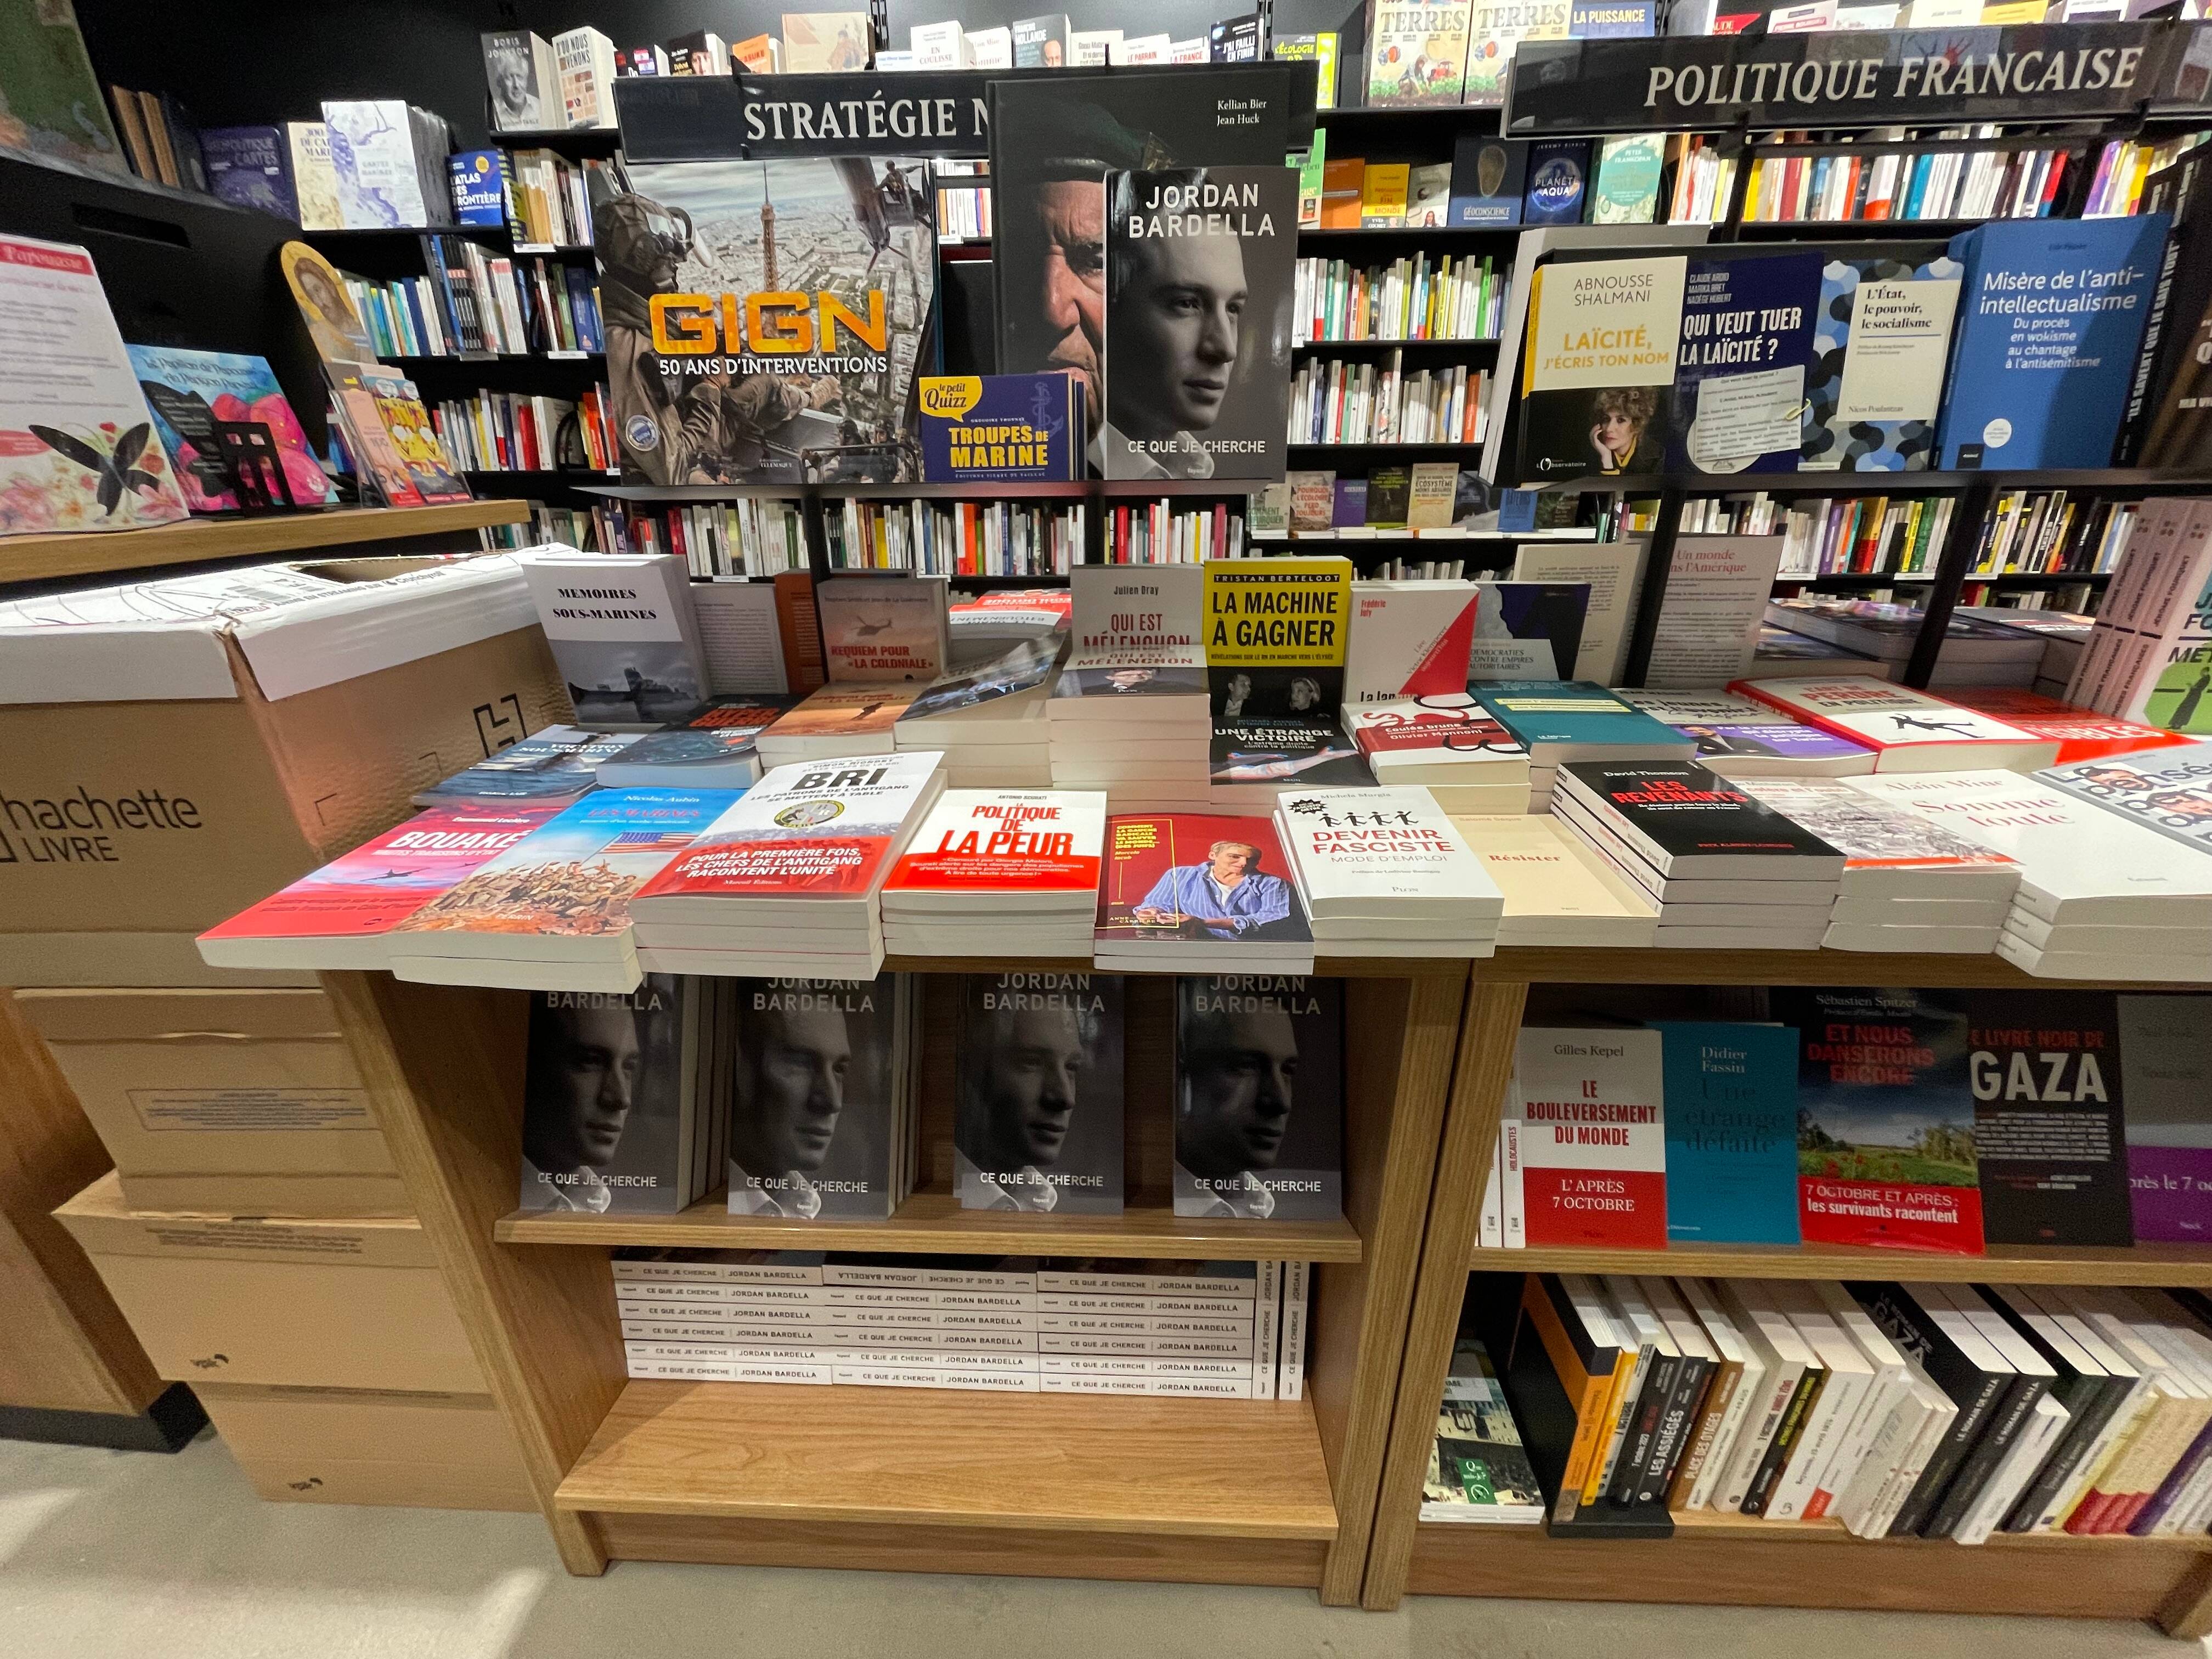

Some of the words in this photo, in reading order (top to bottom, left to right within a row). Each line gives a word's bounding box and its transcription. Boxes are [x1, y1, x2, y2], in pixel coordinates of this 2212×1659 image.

[1381, 10, 1465, 32] TERRES
[1574, 11, 1587, 23] LA
[1589, 9, 1645, 23] PUISSANCE
[494, 37, 520, 48] BORIS
[571, 33, 588, 51] NOUS
[1235, 35, 1255, 50] FAILLI
[567, 49, 590, 69] VENONS
[1135, 52, 1156, 61] PARRAIN
[1180, 53, 1203, 63] FRANCE
[1237, 46, 1254, 60] FINIR
[1644, 59, 1883, 108] POLITIQUE
[1894, 47, 2143, 97] FRANCAISE
[1217, 100, 1247, 110] Kellian
[1250, 99, 1267, 109] Bier
[744, 89, 956, 140] STRATÉGIE
[1217, 115, 1234, 127] Jean
[1238, 115, 1259, 124] Huck
[1145, 184, 1259, 210] JORDAN
[1542, 187, 1568, 196] AQUA
[1128, 213, 1275, 239] BARDELLA
[1575, 274, 1654, 291] ABNOUSSE
[1984, 272, 2046, 290] Misère
[2051, 271, 2074, 289] de
[2079, 267, 2144, 288] l'anti-
[1575, 289, 1650, 307] SHALMANI
[1867, 286, 1906, 300] L'État,
[1864, 304, 1872, 314] le
[1875, 303, 1922, 317] pouvoir,
[1980, 294, 2137, 314] intellectualisme
[649, 290, 887, 354] GIGN
[1684, 314, 1711, 340] QUI
[1716, 311, 1755, 335] VEUT
[1760, 307, 1802, 332] TUER
[1862, 319, 1872, 329] le
[1874, 318, 1932, 328] socialisme
[2014, 318, 2029, 329] Du
[2031, 317, 2069, 330] procès
[1564, 324, 1652, 352] LAÏCITÉ,
[2011, 332, 2024, 342] en
[2027, 330, 2076, 341] wokisme
[1680, 344, 1697, 365] LA
[1703, 335, 1763, 364] LAÏCITÉ
[1768, 338, 1778, 360] ?
[2008, 347, 2021, 356] au
[2024, 345, 2077, 357] chantage
[659, 360, 680, 375] 50
[686, 360, 720, 375] ANS
[725, 357, 887, 375] D'INTERVENTIONS
[1544, 354, 1595, 370] J'ÉCRIS
[1599, 354, 1629, 366] TON
[1633, 352, 1669, 364] NOM
[2006, 358, 2012, 369] à
[2016, 357, 2100, 369] l'antisémitisme
[947, 383, 966, 395] petit
[924, 388, 967, 410] Quizz
[949, 426, 1032, 444] TROUPES
[1036, 431, 1048, 442] DE
[1127, 441, 1146, 454] CE
[1149, 441, 1177, 454] QUE
[1182, 441, 1199, 453] JE
[1203, 441, 1265, 453] CHERCHE
[950, 445, 1048, 467] MARINE
[557, 589, 636, 599] MEMOIRES
[1114, 586, 1138, 595] Julien
[1142, 585, 1159, 595] Dray
[1213, 592, 1237, 613] LA
[1244, 592, 1339, 613] MACHINE
[552, 609, 657, 620] SOUS-MARINES
[1111, 614, 1133, 634] QUI
[1140, 614, 1163, 631] EST
[1212, 618, 1228, 646] À
[1237, 620, 1335, 646] GAGNER
[831, 646, 877, 658] REQUIEM
[880, 646, 910, 656] POUR
[1256, 728, 1334, 736] ÉTRANGE
[790, 768, 888, 791] BRI
[1641, 781, 1688, 791] LES
[1884, 781, 1943, 792] Alain
[1948, 779, 2004, 788] Minc
[1611, 791, 1748, 803] REVENANTS
[1912, 797, 2065, 813] Somme
[0, 784, 202, 830] hachette
[972, 806, 1062, 821] POLITIQUE
[1000, 819, 1025, 832] DE
[1966, 812, 2075, 828] toute
[387, 830, 533, 848] BOUAKÉ
[936, 830, 979, 854] LA
[985, 832, 1074, 856] PEUR
[1312, 830, 1443, 841] DEVENIR
[23, 836, 119, 862] LIVRE
[689, 853, 727, 864] POUR
[729, 850, 748, 859] LA
[754, 848, 825, 859] PREMIÈRE
[826, 848, 861, 856] FOIS,
[1313, 842, 1455, 854] FASCISTE
[675, 864, 703, 872] LES
[705, 860, 746, 870] CHEFS
[752, 858, 771, 867] DE
[776, 857, 862, 866] L'ANTIGANG
[1489, 854, 1561, 862] Résister
[687, 868, 778, 878] RACONTENT
[782, 866, 837, 876] L'UNITÉ
[997, 974, 1091, 989] JORDAN
[754, 994, 875, 1013] BARDELLA
[983, 994, 1105, 1012] BARDELLA
[1554, 1045, 1587, 1056] Gilles
[1591, 1046, 1624, 1058] Kepel
[1702, 1047, 1747, 1060] Didier
[1702, 1061, 1746, 1073] Fassin
[1971, 1051, 2108, 1102] GAZA
[1583, 1080, 1597, 1097] LE
[1527, 1102, 1656, 1123] BOULEVERSEMENT
[1555, 1126, 1575, 1144] DU
[1578, 1126, 1629, 1146] MONDE
[980, 1173, 996, 1184] CE
[999, 1173, 1024, 1185] QUE
[1027, 1173, 1042, 1186] JE
[1046, 1175, 1103, 1186] CHERCHE
[1807, 1185, 1814, 1196] 7
[1816, 1186, 1881, 1200] OCTOBRE
[1885, 1189, 1903, 1202] ET
[1553, 1197, 1560, 1209] 7
[1564, 1198, 1635, 1211] OCTOBRE
[1807, 1200, 1825, 1214] les
[1829, 1203, 1892, 1218] survivants
[1895, 1205, 1958, 1223] racontent
[1158, 1282, 1192, 1290] JORDAN
[1195, 1283, 1240, 1291] BARDELLA
[1656, 1410, 1684, 1458] ASSIÉGÉS
[1649, 1459, 1666, 1475] LES
